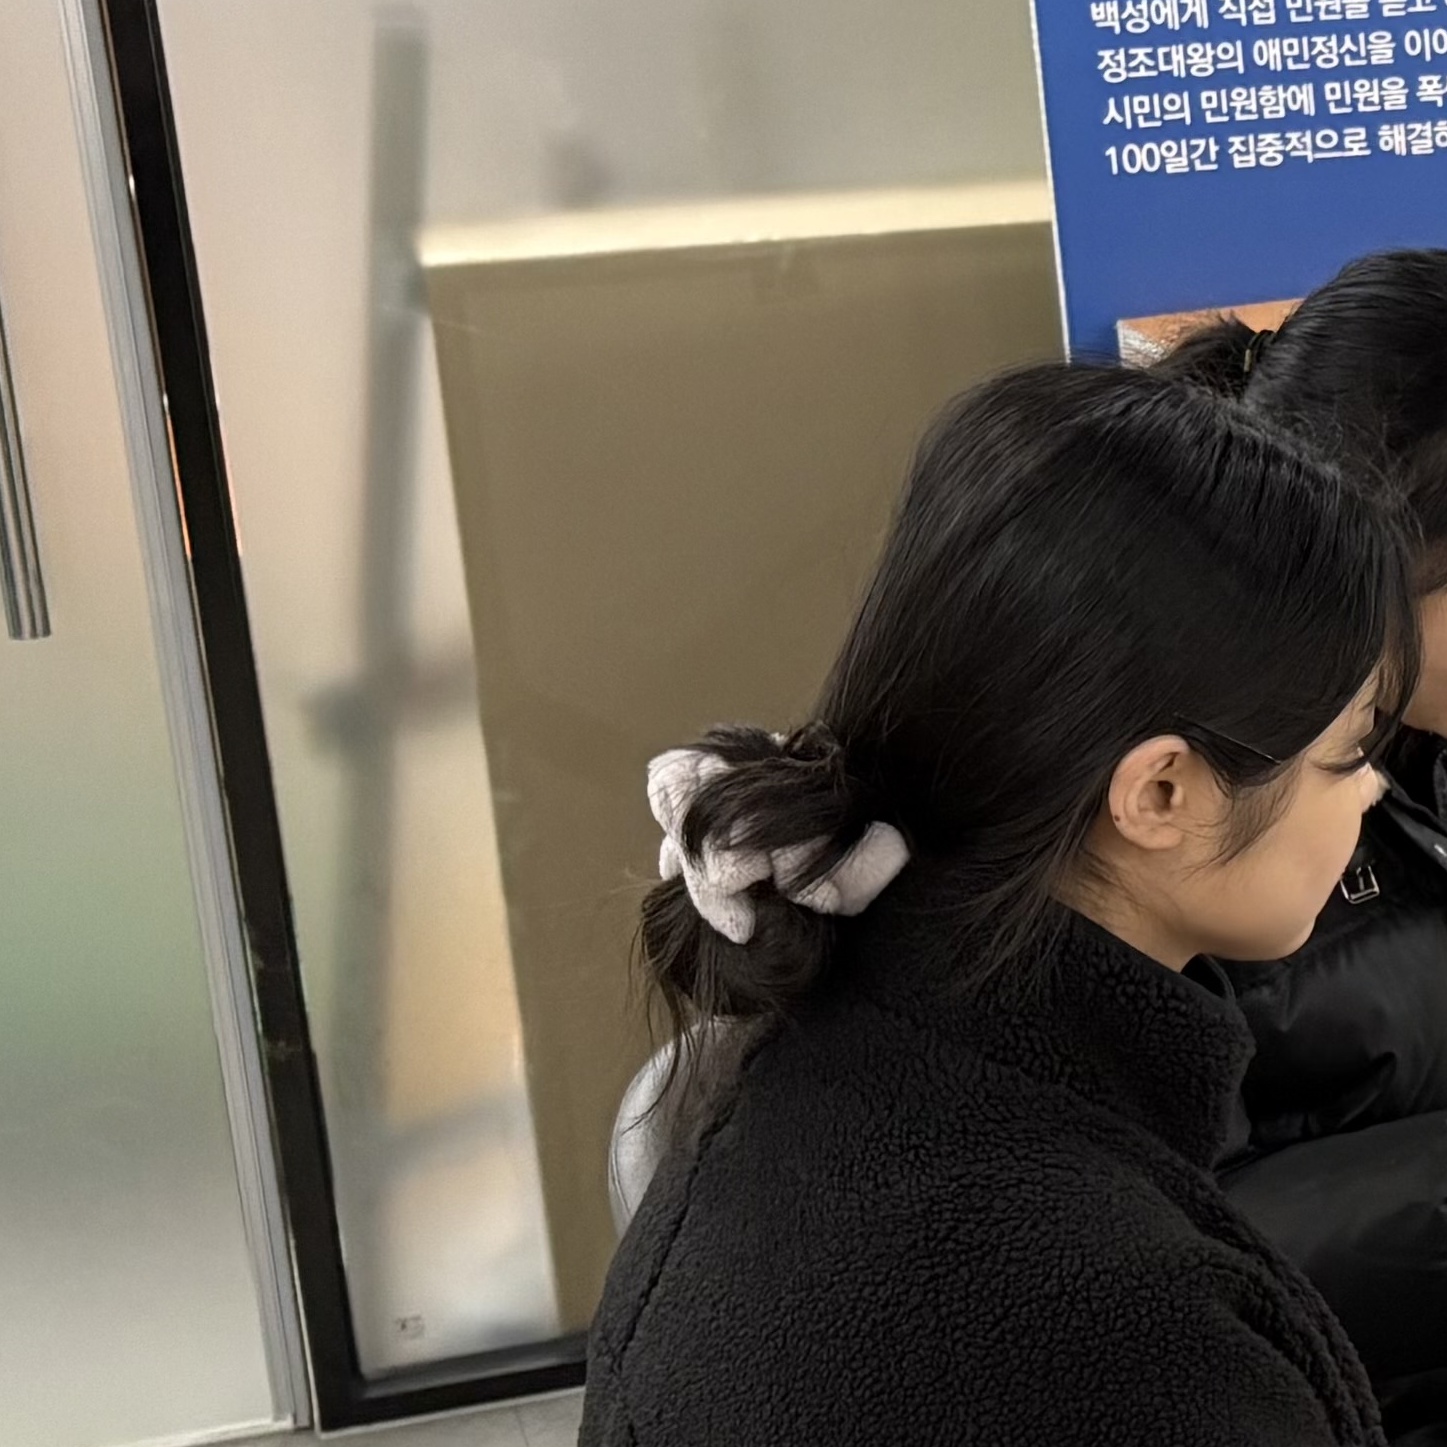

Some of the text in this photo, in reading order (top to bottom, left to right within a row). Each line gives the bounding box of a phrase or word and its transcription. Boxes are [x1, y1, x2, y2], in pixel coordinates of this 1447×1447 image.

[1090, 0, 1209, 34] 백성에게
[1218, 0, 1276, 26] 직접
[1097, 40, 1245, 83] 정조대왕의
[1252, 30, 1396, 72] 애민정신을
[1103, 91, 1191, 130] 시민의
[1200, 83, 1316, 123] 민원함에
[1324, 76, 1409, 114] 민원을
[1105, 137, 1220, 175] 100일간
[1228, 127, 1371, 169] 집중적으로
